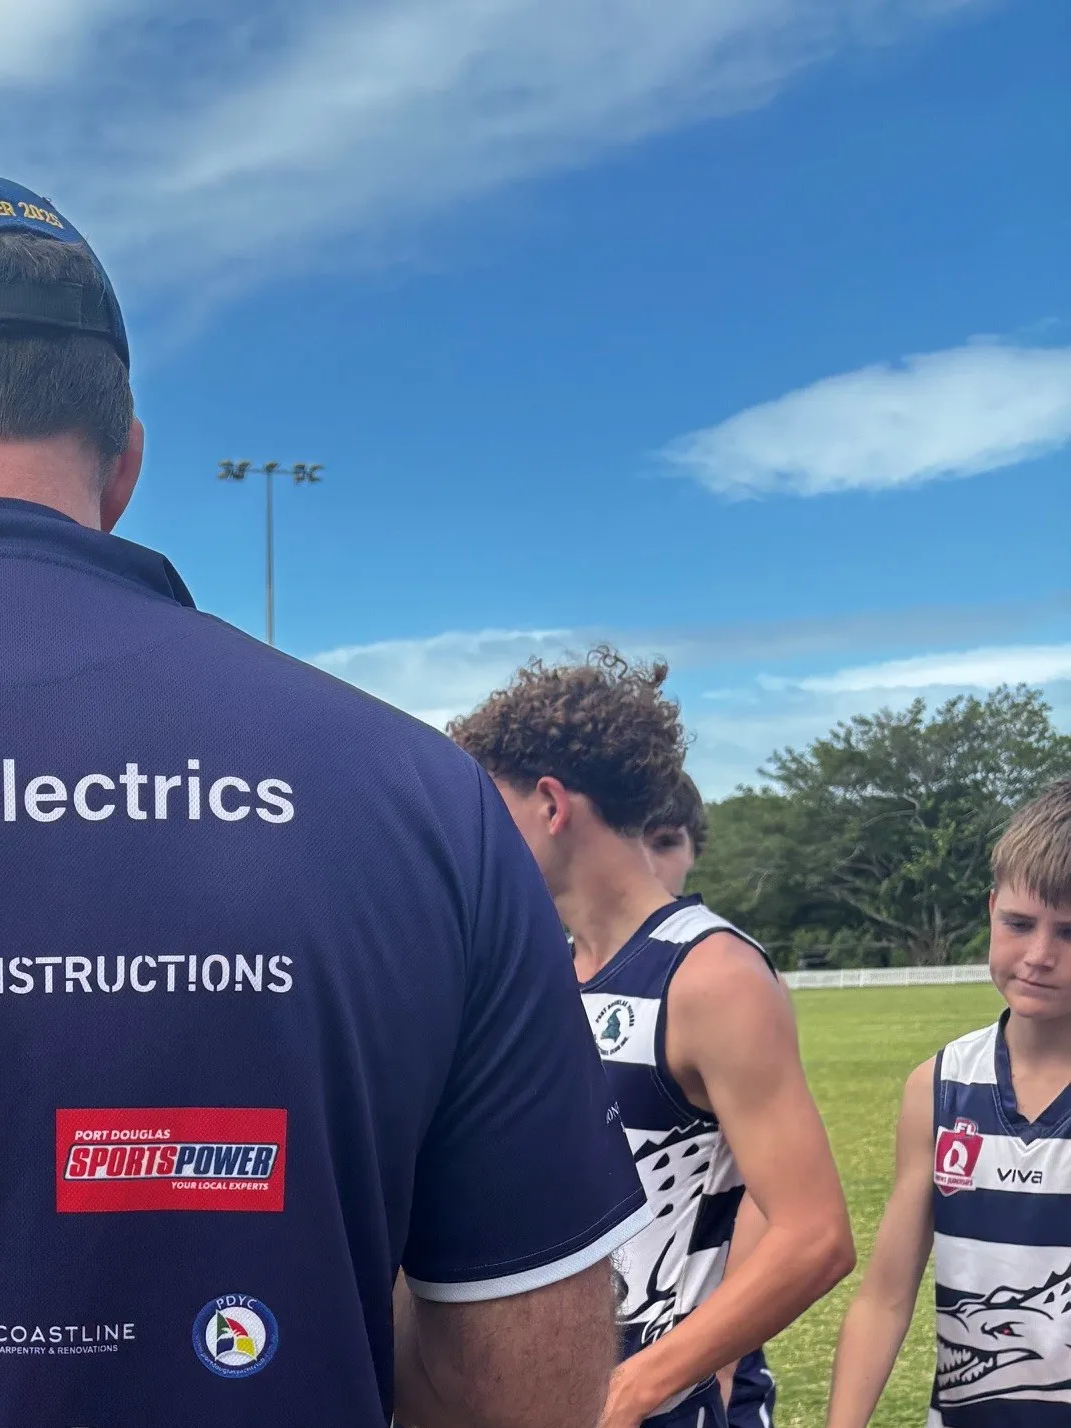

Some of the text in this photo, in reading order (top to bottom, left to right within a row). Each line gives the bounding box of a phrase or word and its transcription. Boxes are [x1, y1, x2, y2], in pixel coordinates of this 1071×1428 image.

[75, 1129, 171, 1141] PORT DOUGLAS
[68, 1146, 274, 1177] SPORTSPOWER
[943, 1141, 968, 1175] Q
[171, 1182, 269, 1190] YOUR LOCAL EXPERTS
[216, 1295, 257, 1309] PDYC
[48, 1346, 55, 1354] &
[58, 1345, 119, 1355] RENOVATIONS
